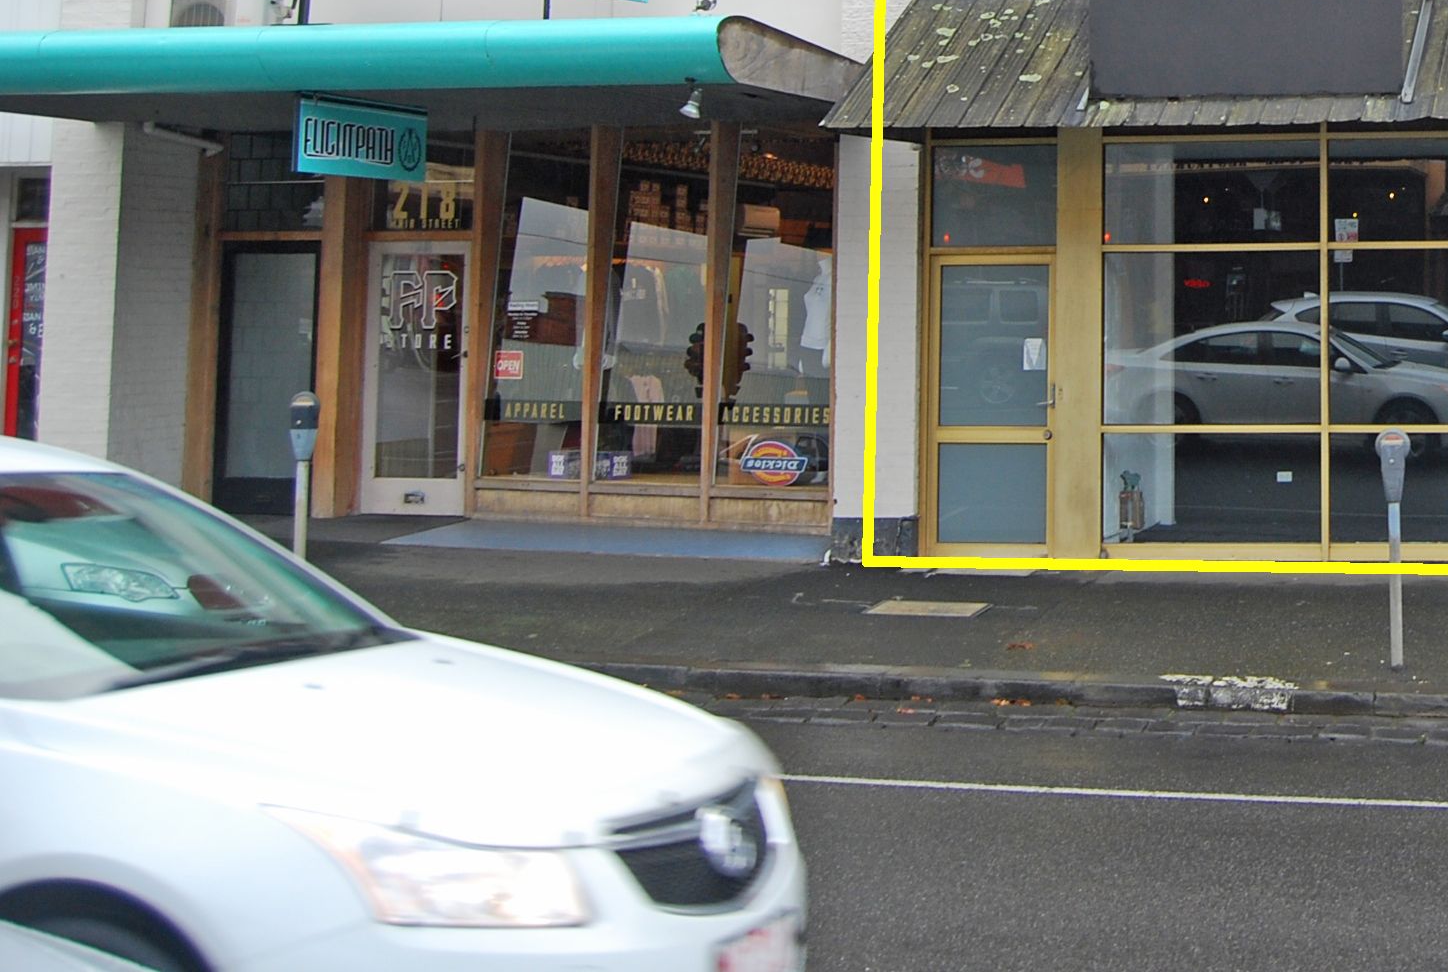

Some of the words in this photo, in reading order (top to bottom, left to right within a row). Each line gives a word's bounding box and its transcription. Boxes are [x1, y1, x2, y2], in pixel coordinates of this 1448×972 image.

[392, 184, 456, 219] 218
[421, 218, 460, 229] STREET
[384, 333, 452, 350] STORE
[497, 360, 520, 374] OPEN
[505, 403, 565, 418] APPAREL
[615, 404, 696, 421] FOOTWEAR
[722, 406, 830, 424] ACCESSORIES
